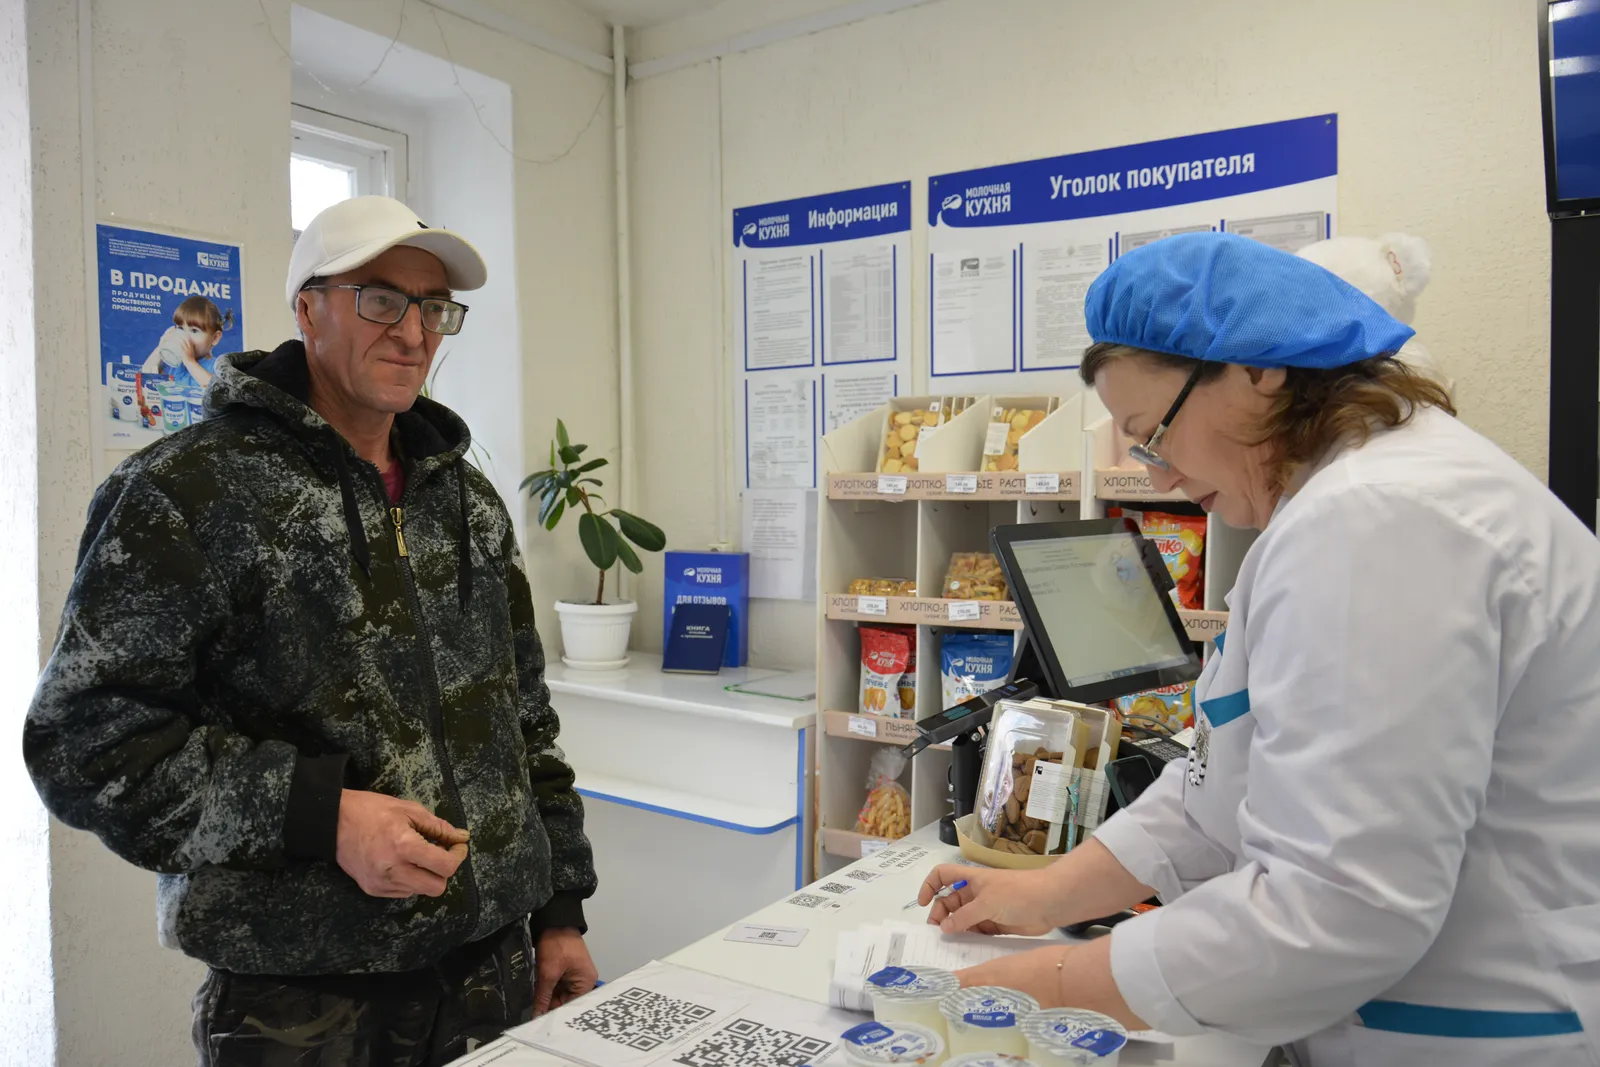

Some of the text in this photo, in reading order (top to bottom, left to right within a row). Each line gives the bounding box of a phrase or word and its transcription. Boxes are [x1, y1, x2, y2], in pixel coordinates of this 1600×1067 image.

[1049, 152, 1255, 200] Уголок покупателя
[965, 182, 1011, 199] МОЛОЧНАЯ
[965, 195, 1011, 217] КУХНЯ
[758, 214, 790, 227] МОЛОЧНАЯ
[808, 201, 898, 230] Информация
[758, 223, 790, 241] КУХНЯ
[209, 259, 230, 269] КУХНЯ
[110, 269, 231, 299] В ПРОДАЖЕ
[111, 290, 161, 301] ПРОДУКЦИЯ
[111, 297, 161, 308] СОБСТВЕННОГО
[111, 304, 161, 315] ПРОИЗВОДСТВА
[696, 573, 722, 584] КУХНЯ
[676, 594, 727, 606] ДЛЯ ОТЗЫВОВ
[965, 663, 993, 674] КУХНЯ
